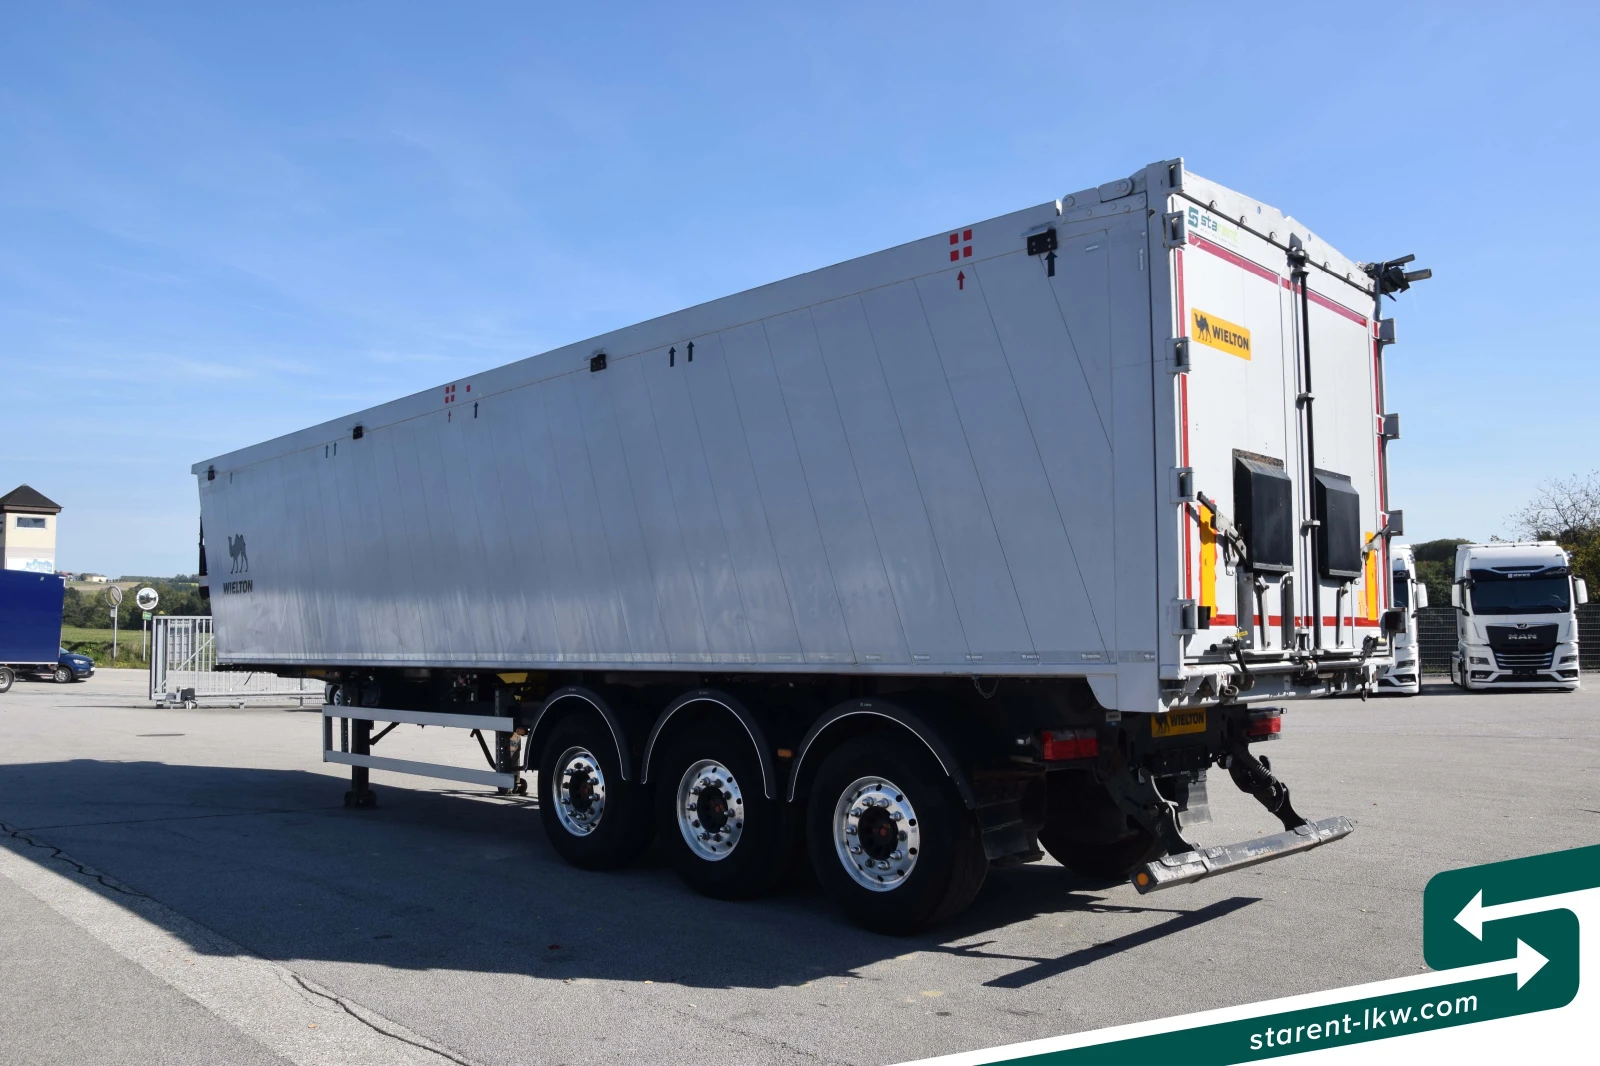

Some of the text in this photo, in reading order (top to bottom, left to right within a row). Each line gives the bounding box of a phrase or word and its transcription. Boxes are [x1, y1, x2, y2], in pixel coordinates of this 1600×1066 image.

[1212, 325, 1249, 351] WIELTON
[223, 580, 253, 594] WIELTON
[1171, 711, 1204, 726] WIELTON
